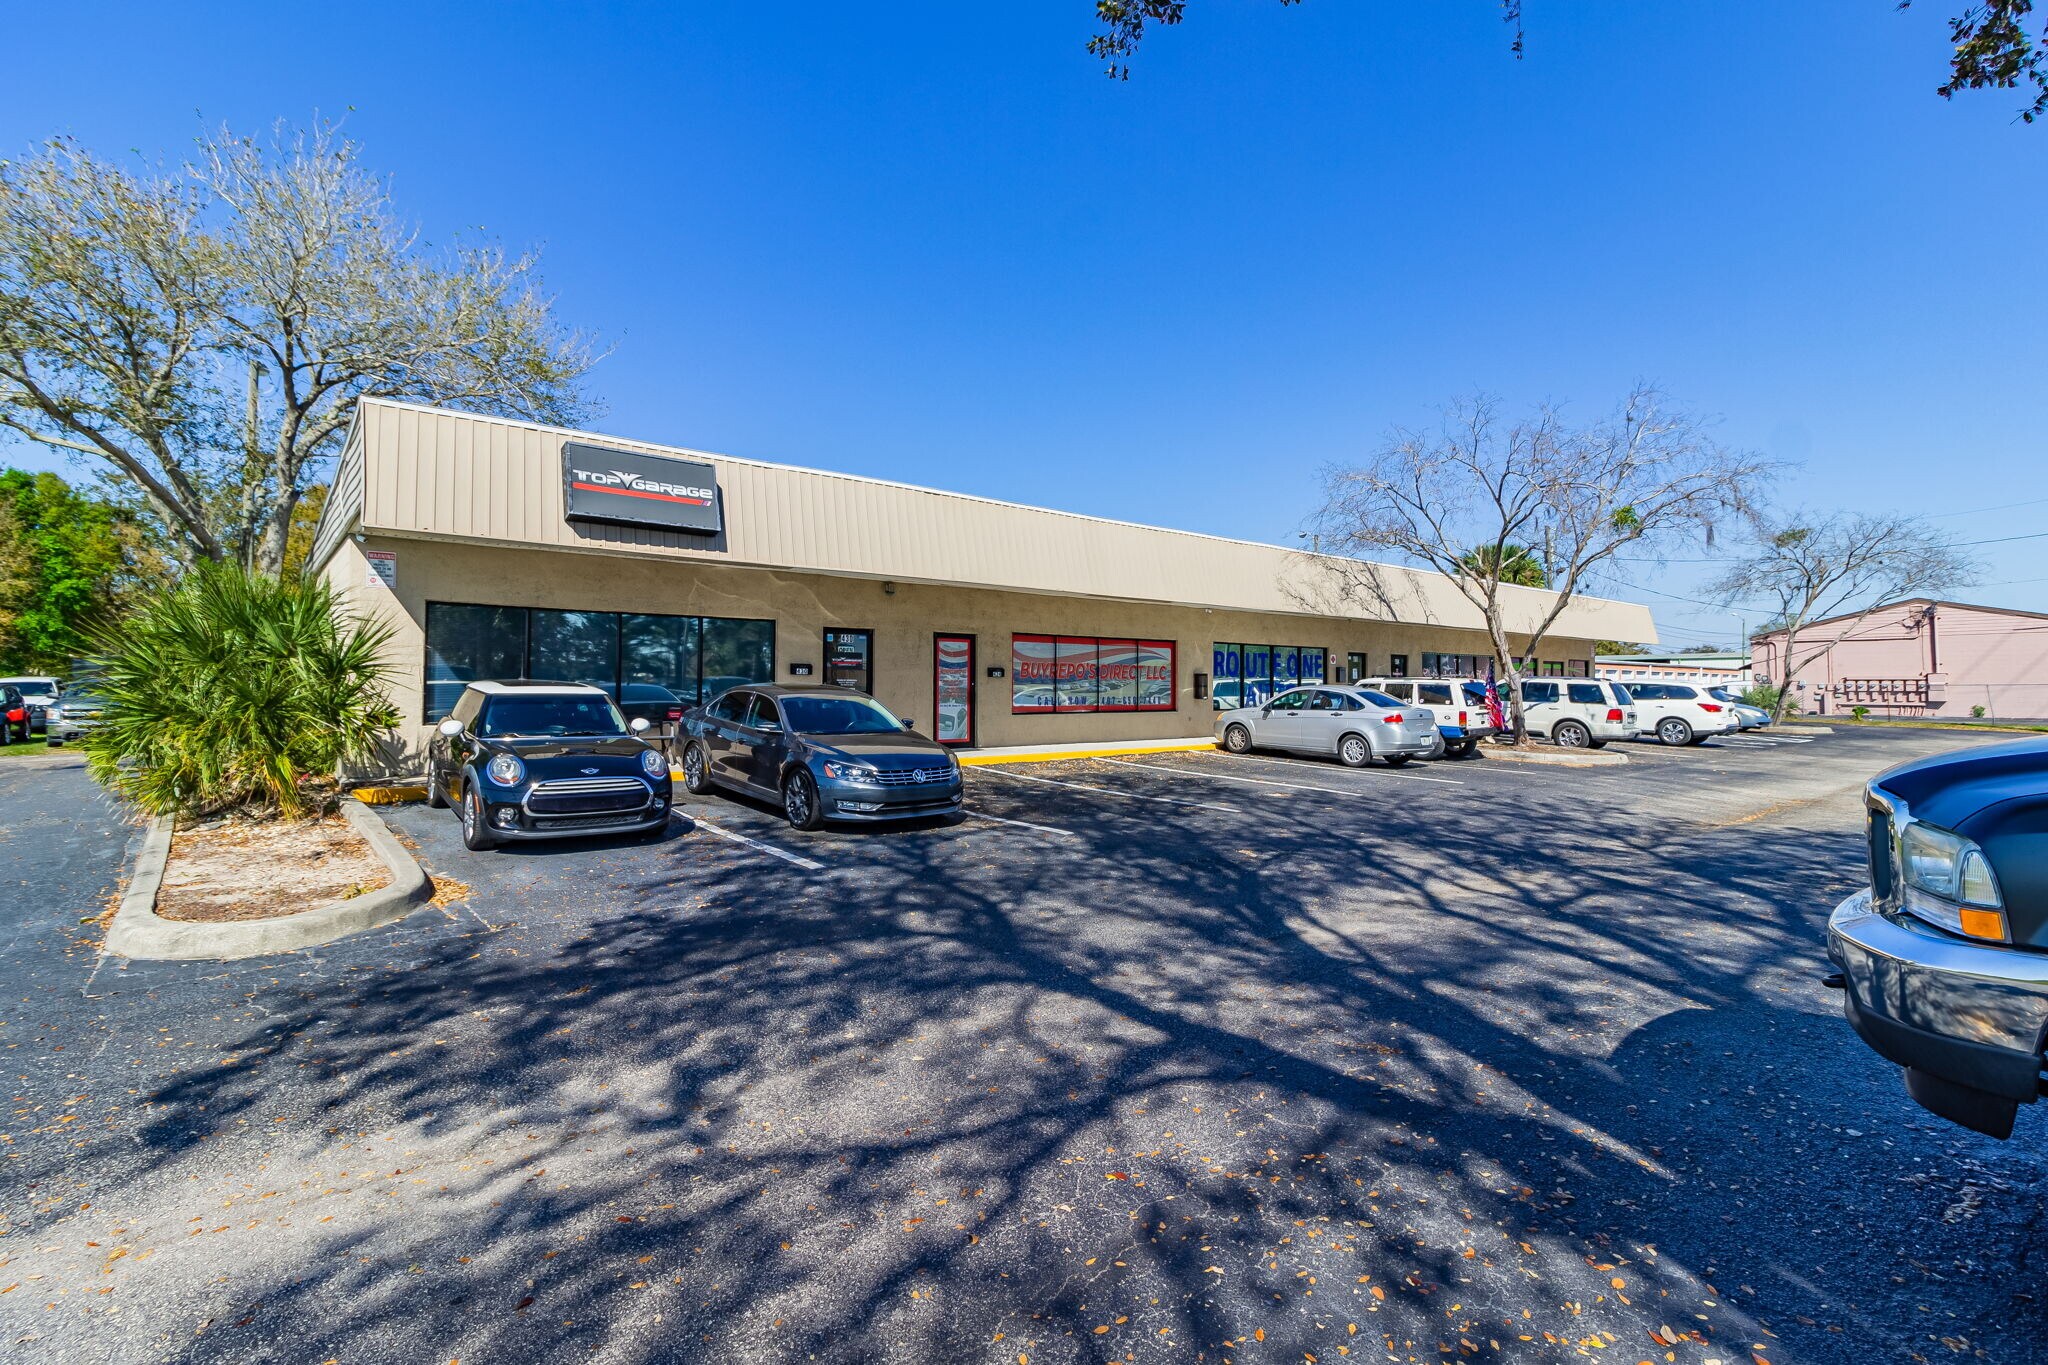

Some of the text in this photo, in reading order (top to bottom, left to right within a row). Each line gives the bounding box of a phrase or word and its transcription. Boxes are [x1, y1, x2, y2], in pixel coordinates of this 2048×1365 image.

[573, 469, 621, 485] TOP
[1099, 664, 1144, 681] DIRECT
[1145, 665, 1167, 681] LLC
[1213, 651, 1323, 678] ROUTE ONE
[1037, 696, 1062, 706] CALL
